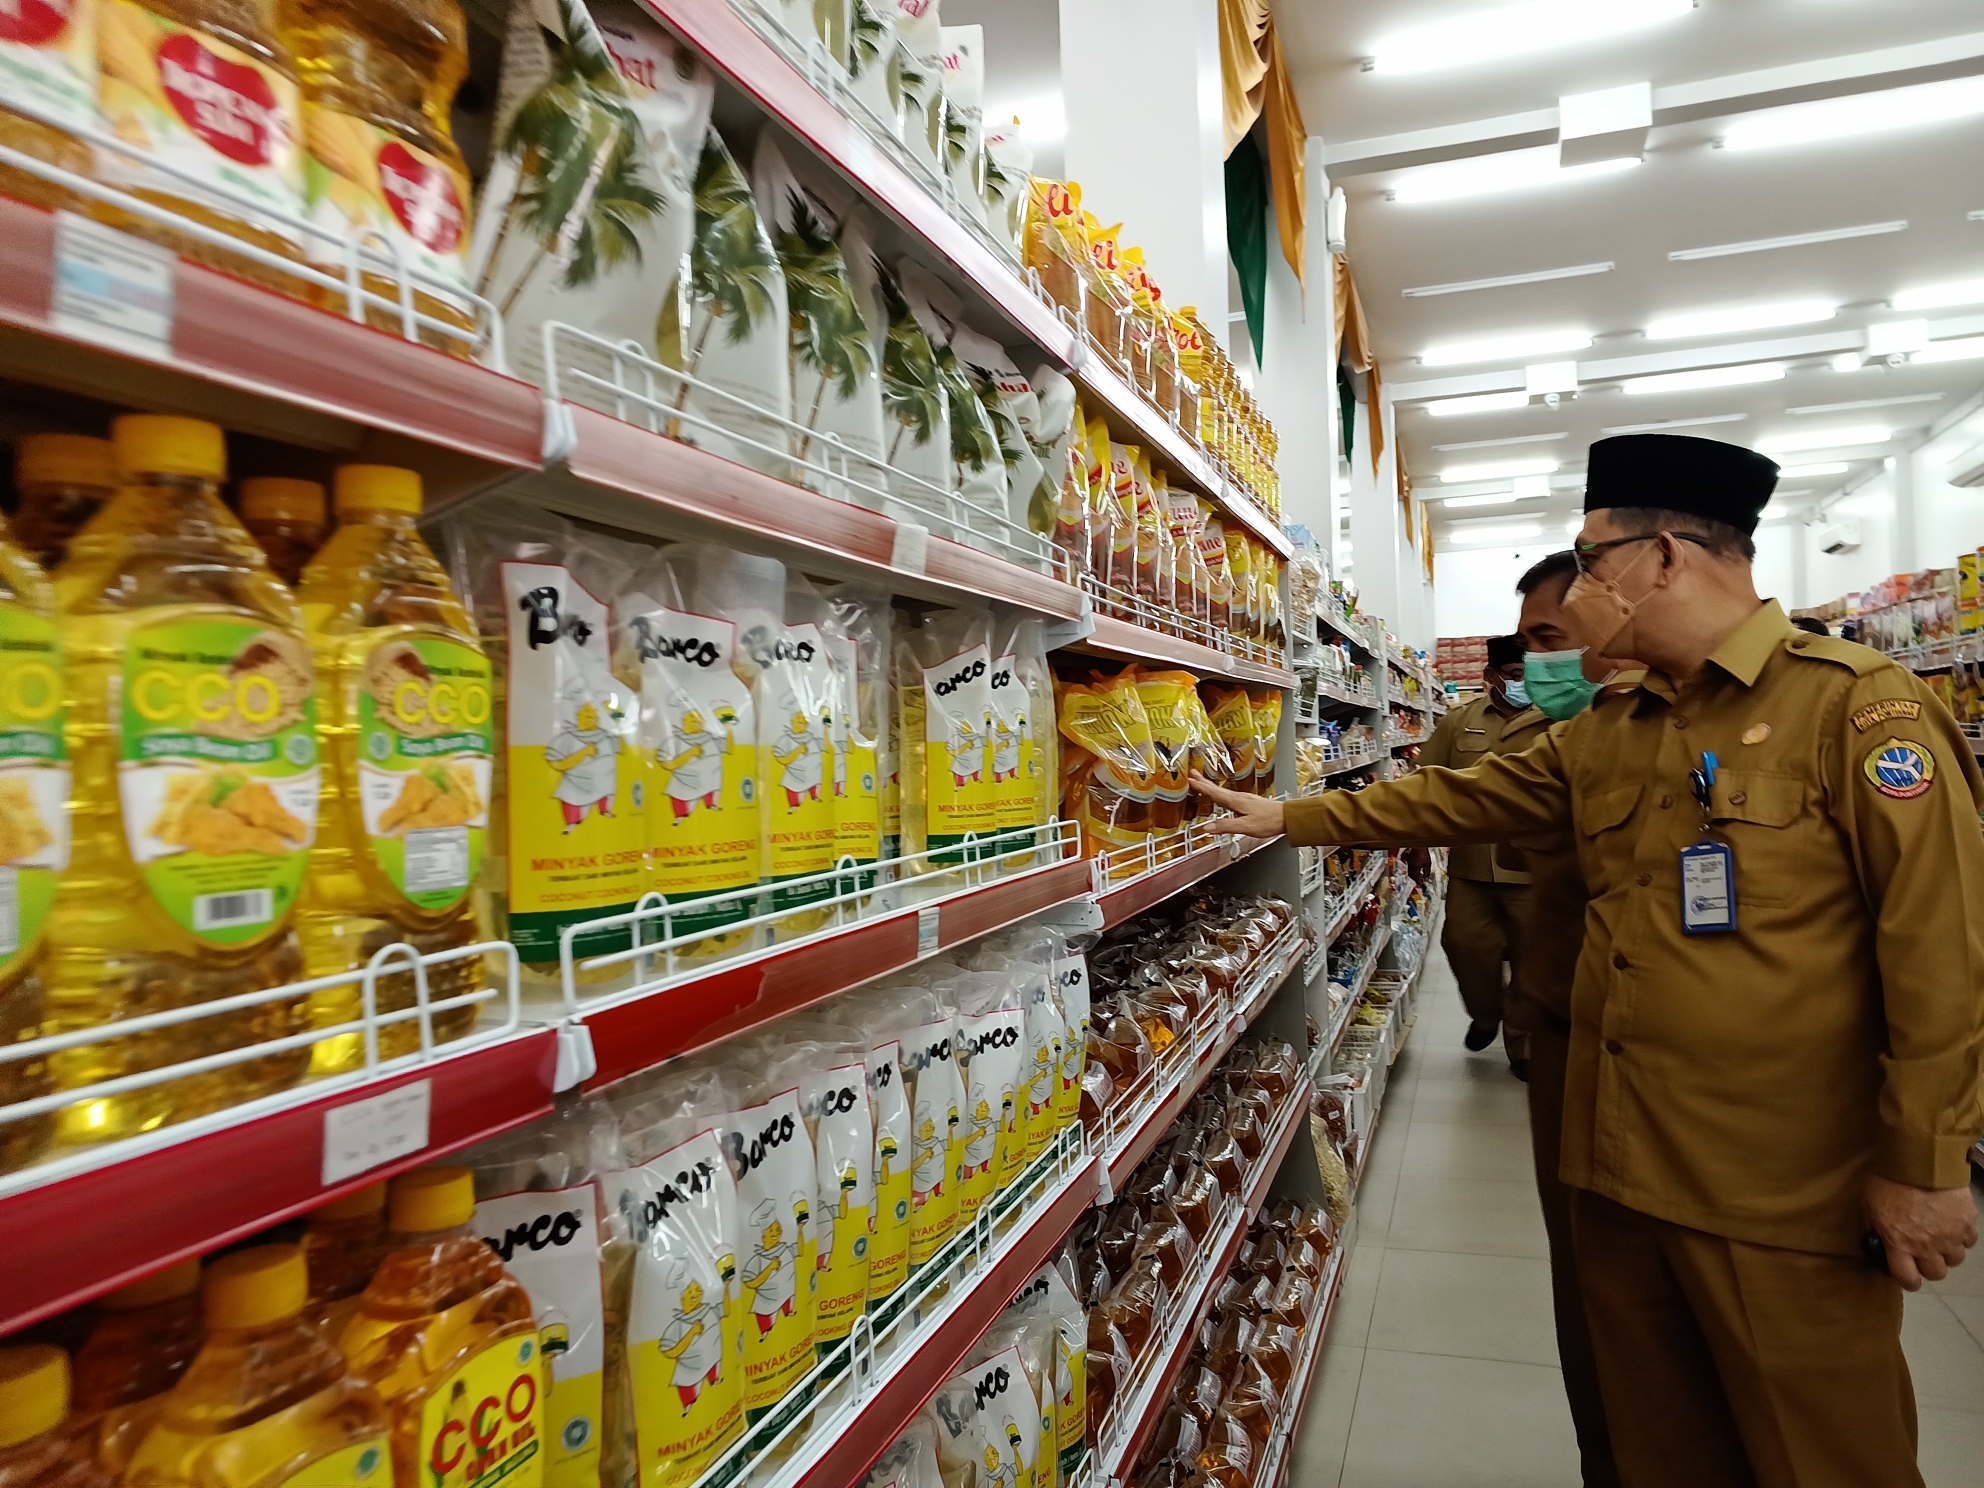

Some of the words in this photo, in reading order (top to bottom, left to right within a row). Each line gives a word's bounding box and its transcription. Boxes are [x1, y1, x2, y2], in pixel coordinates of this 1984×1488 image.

[934, 660, 987, 697] arco
[132, 669, 281, 724] CCO
[840, 821, 877, 833] GORENG
[711, 838, 757, 855] GORENG
[530, 855, 598, 872] MINYAK
[721, 1113, 796, 1183] Barco
[870, 1249, 907, 1271] GORENG
[818, 1288, 865, 1312] GORENG
[432, 1373, 537, 1475] CCO
[657, 1423, 713, 1458] MINYAK
[1037, 1466, 1051, 1485] ENG
